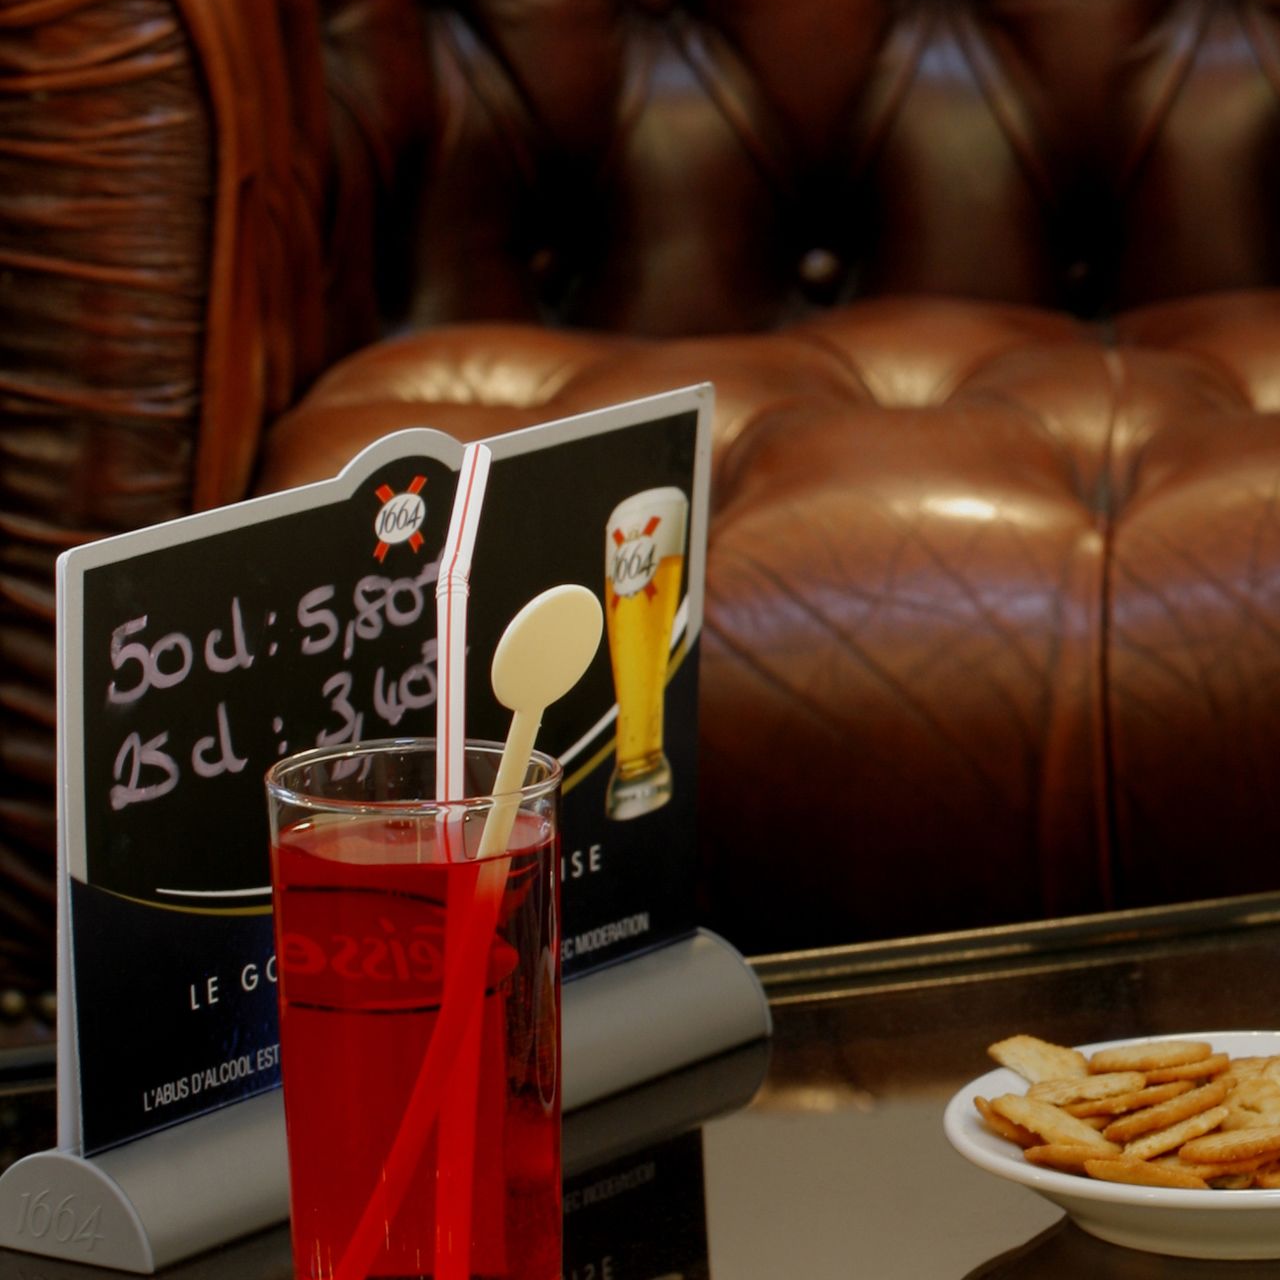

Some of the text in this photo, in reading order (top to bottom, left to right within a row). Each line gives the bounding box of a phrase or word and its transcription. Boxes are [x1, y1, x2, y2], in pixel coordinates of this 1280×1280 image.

[378, 500, 422, 535] 1664
[612, 544, 656, 583] 1664
[109, 614, 193, 704] 50
[298, 562, 440, 660] 5,80
[317, 640, 440, 748] 3,40
[190, 976, 220, 1011] LE
[143, 1043, 280, 1112] L'ABUS D'ALCOOL EST
[18, 1188, 104, 1253] 1664
